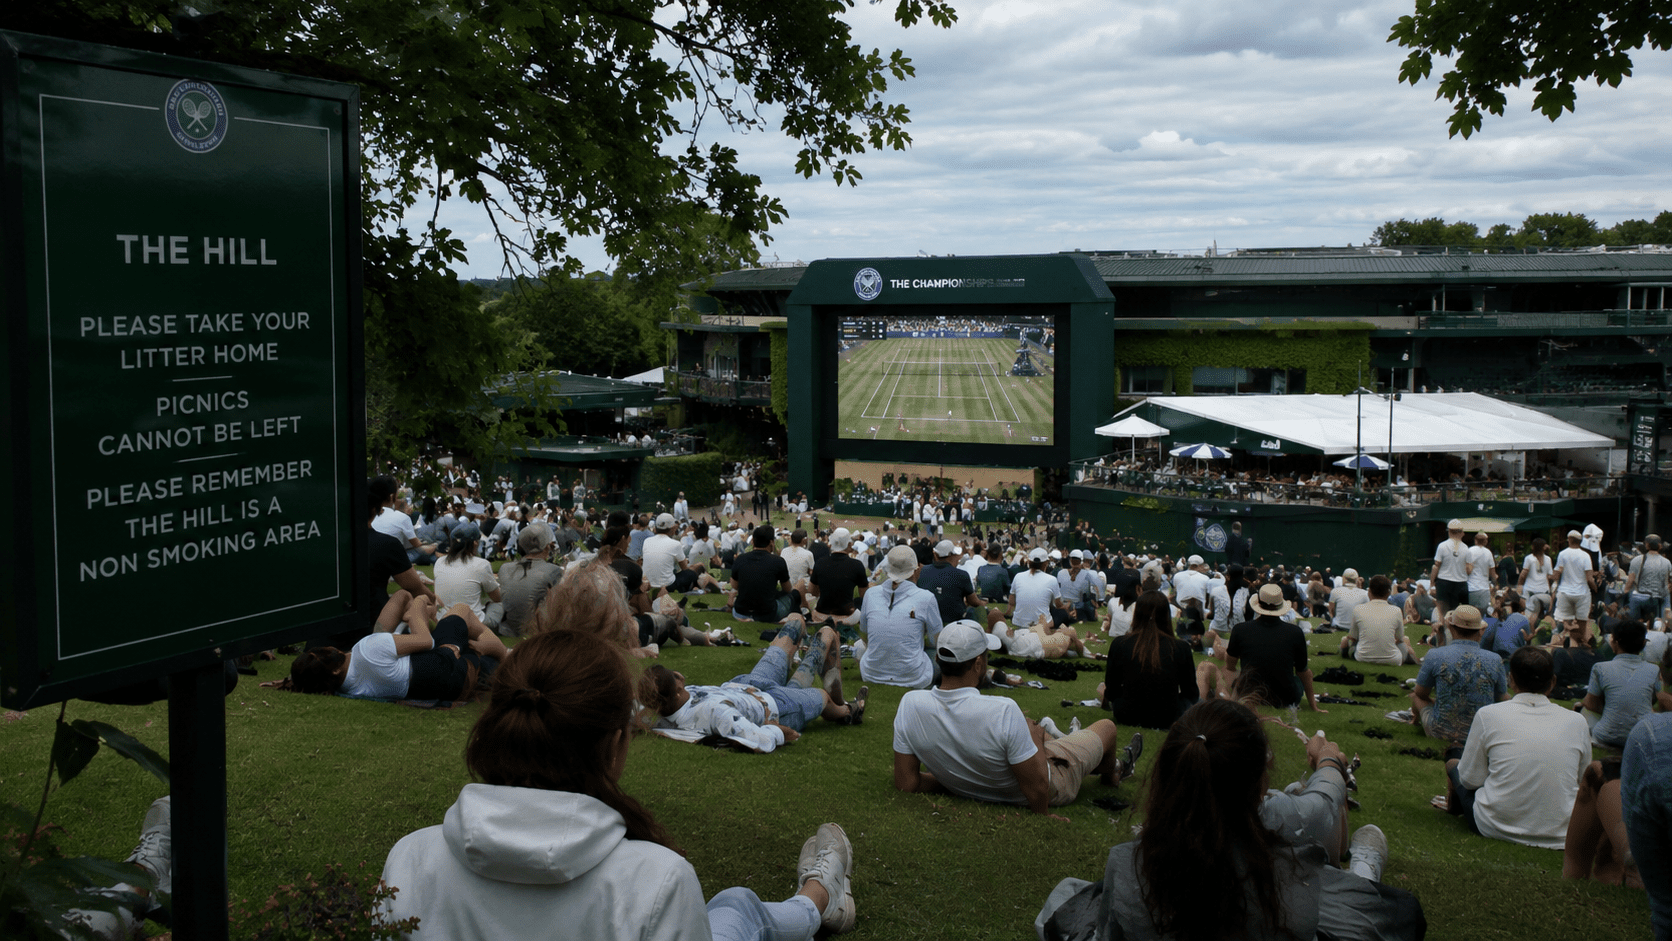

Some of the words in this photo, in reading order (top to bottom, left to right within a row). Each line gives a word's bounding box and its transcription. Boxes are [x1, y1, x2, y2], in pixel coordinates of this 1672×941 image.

[116, 234, 189, 264] THE
[203, 236, 277, 265] HILL
[890, 279, 910, 288] THE
[80, 314, 177, 337] PLEASE
[185, 313, 244, 333] TAKE
[252, 312, 310, 331] YOUR
[121, 346, 205, 369] LITTER
[214, 342, 278, 364] HOME
[157, 390, 249, 417] PICNICS
[98, 425, 206, 455] CANNOT
[214, 421, 242, 443] BE
[251, 415, 302, 438] LEFT
[87, 477, 183, 509] PLEASE
[192, 459, 312, 494] REMEMBER
[125, 512, 174, 539] THE
[183, 504, 233, 529] HILL
[241, 499, 260, 519] IS
[267, 496, 282, 515] A
[80, 553, 137, 582] NON
[147, 531, 256, 568] SMOKING
[263, 520, 321, 544] AREA
